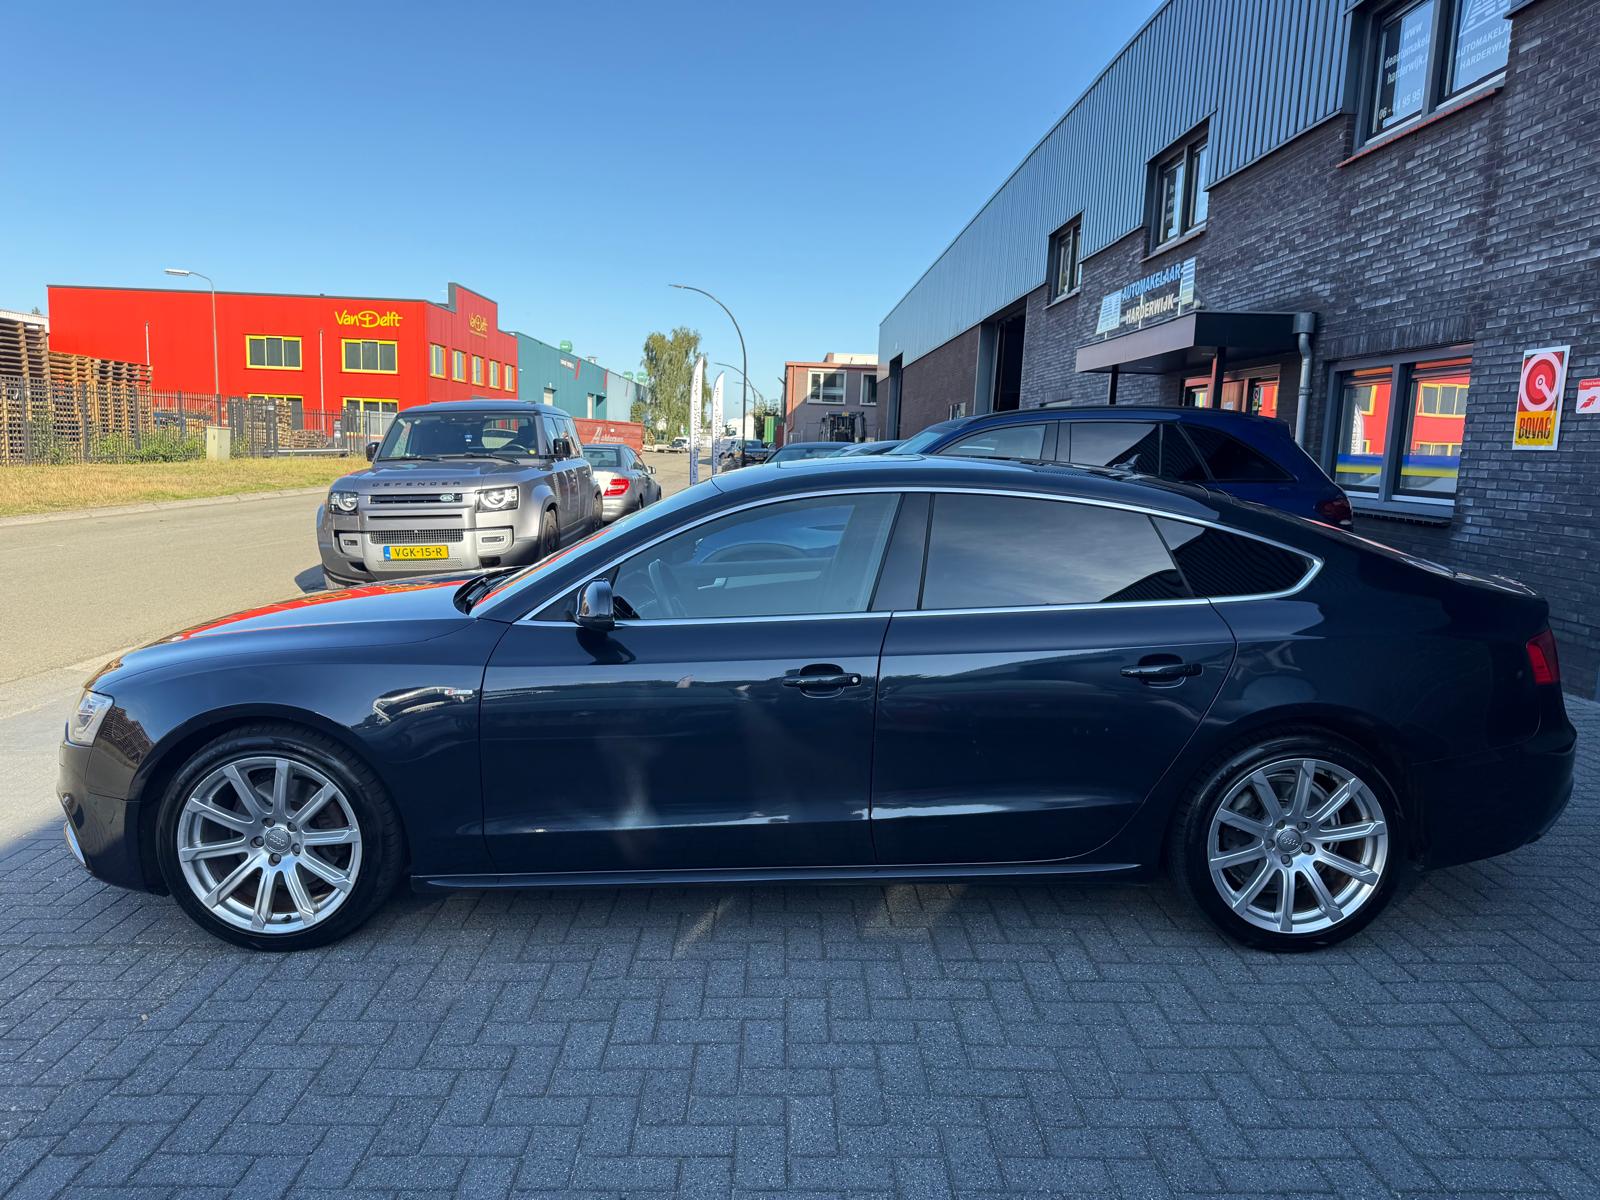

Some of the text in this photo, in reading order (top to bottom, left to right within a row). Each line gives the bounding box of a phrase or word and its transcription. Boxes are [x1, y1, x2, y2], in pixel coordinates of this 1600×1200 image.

[1460, 38, 1510, 70] HARDERWIJ
[1122, 263, 1180, 301] AUTOMAKELAAR
[1126, 293, 1174, 325] HARDERWIJK
[1518, 416, 1552, 439] BOVAG
[394, 548, 442, 557] VGK-15-R
